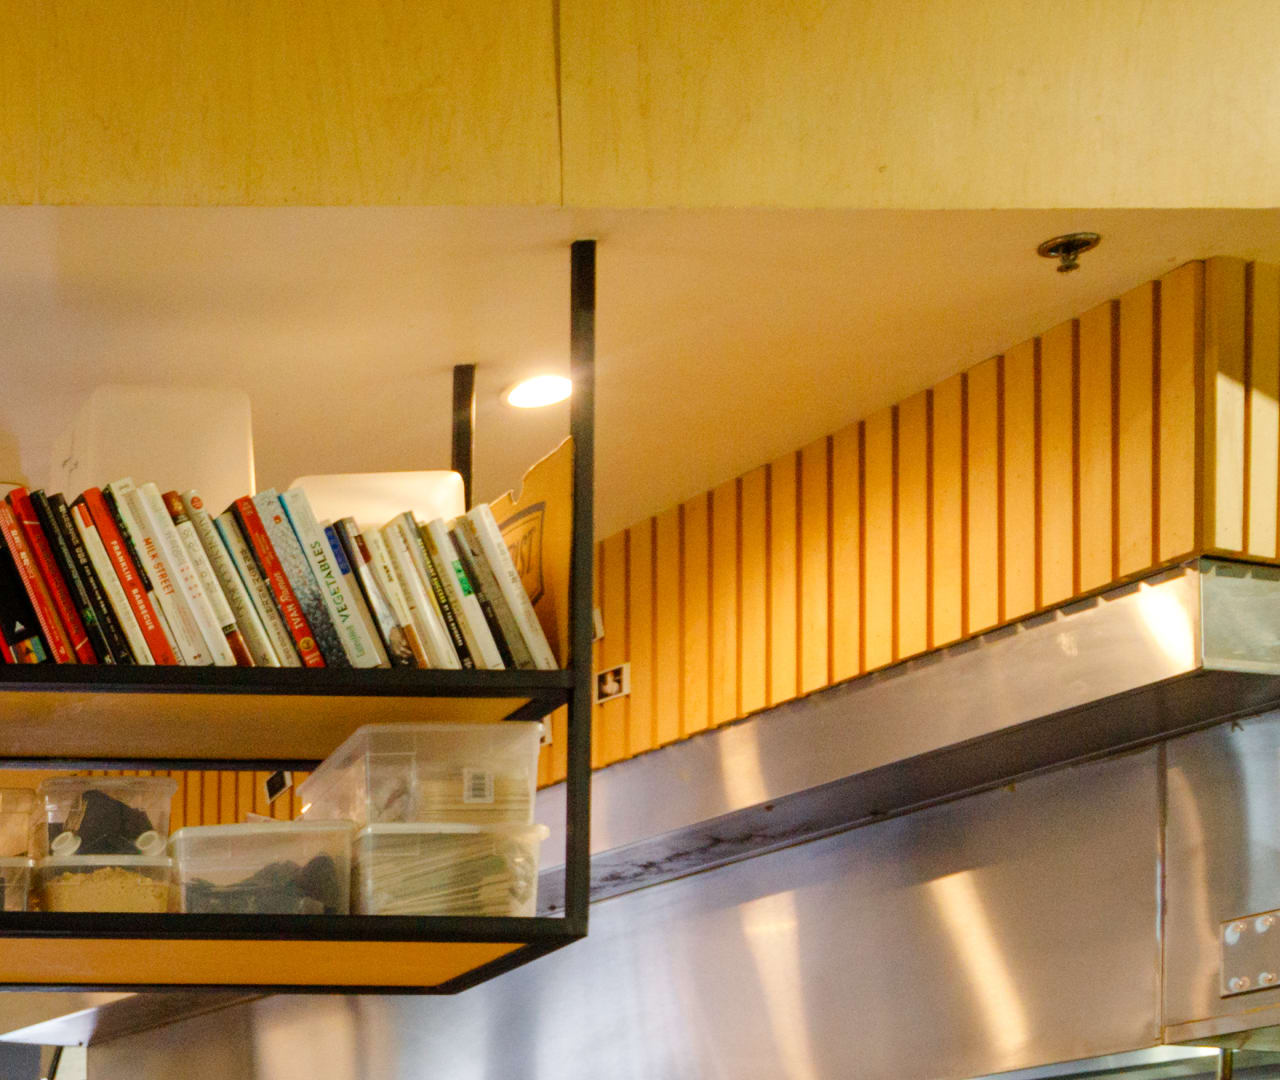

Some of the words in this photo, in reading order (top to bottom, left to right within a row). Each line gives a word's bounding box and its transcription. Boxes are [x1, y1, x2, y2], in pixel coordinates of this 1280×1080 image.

[110, 539, 132, 581] FRANKLIN
[131, 587, 155, 631] BARBECUE
[143, 537, 158, 561] MILK
[152, 558, 176, 596] STREET
[310, 539, 350, 624] VEGETABLES
[285, 604, 304, 630] IVAN
